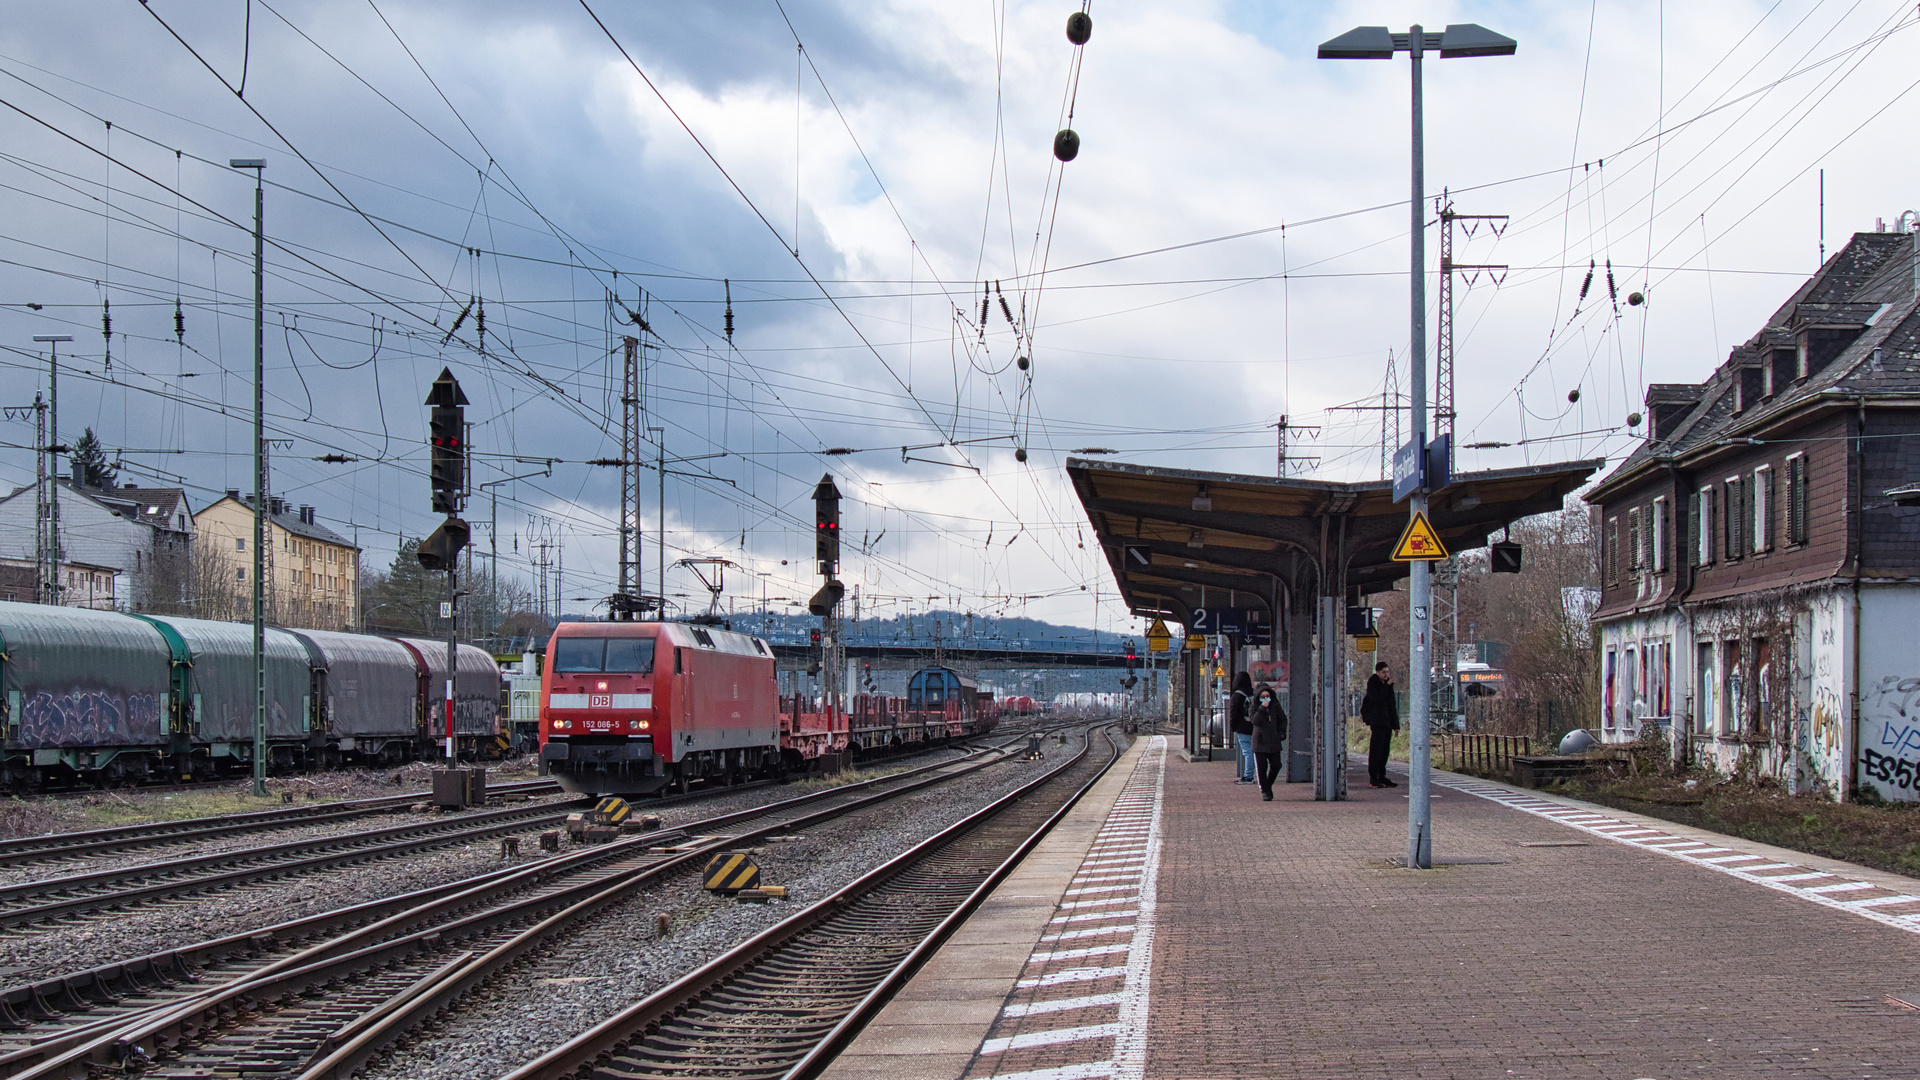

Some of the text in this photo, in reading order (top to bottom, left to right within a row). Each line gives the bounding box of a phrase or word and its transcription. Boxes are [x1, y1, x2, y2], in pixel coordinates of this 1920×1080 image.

[1193, 608, 1207, 629] 2
[1361, 608, 1370, 629] 1
[593, 696, 609, 706] DB
